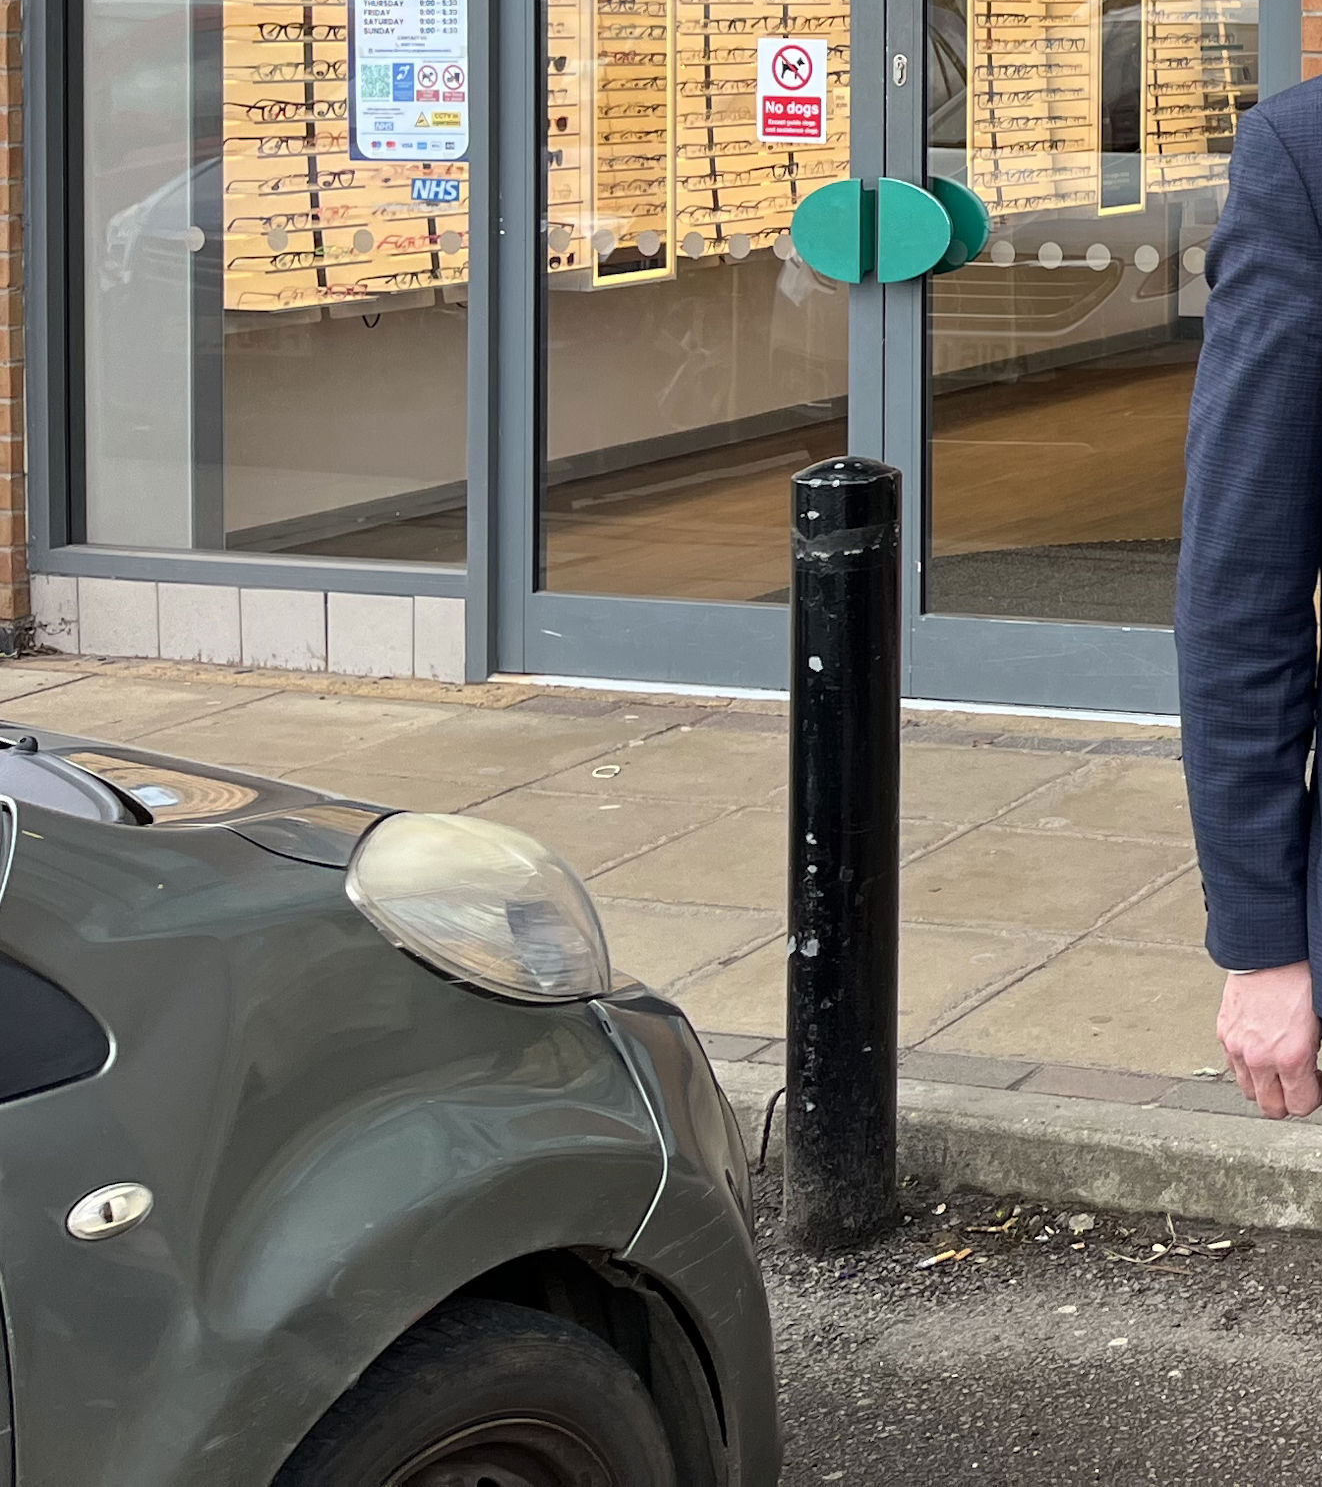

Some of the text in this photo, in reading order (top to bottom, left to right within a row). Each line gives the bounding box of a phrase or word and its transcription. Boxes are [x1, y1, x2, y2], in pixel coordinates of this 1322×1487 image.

[765, 101, 819, 118] No dogs
[412, 180, 458, 200] NHS
